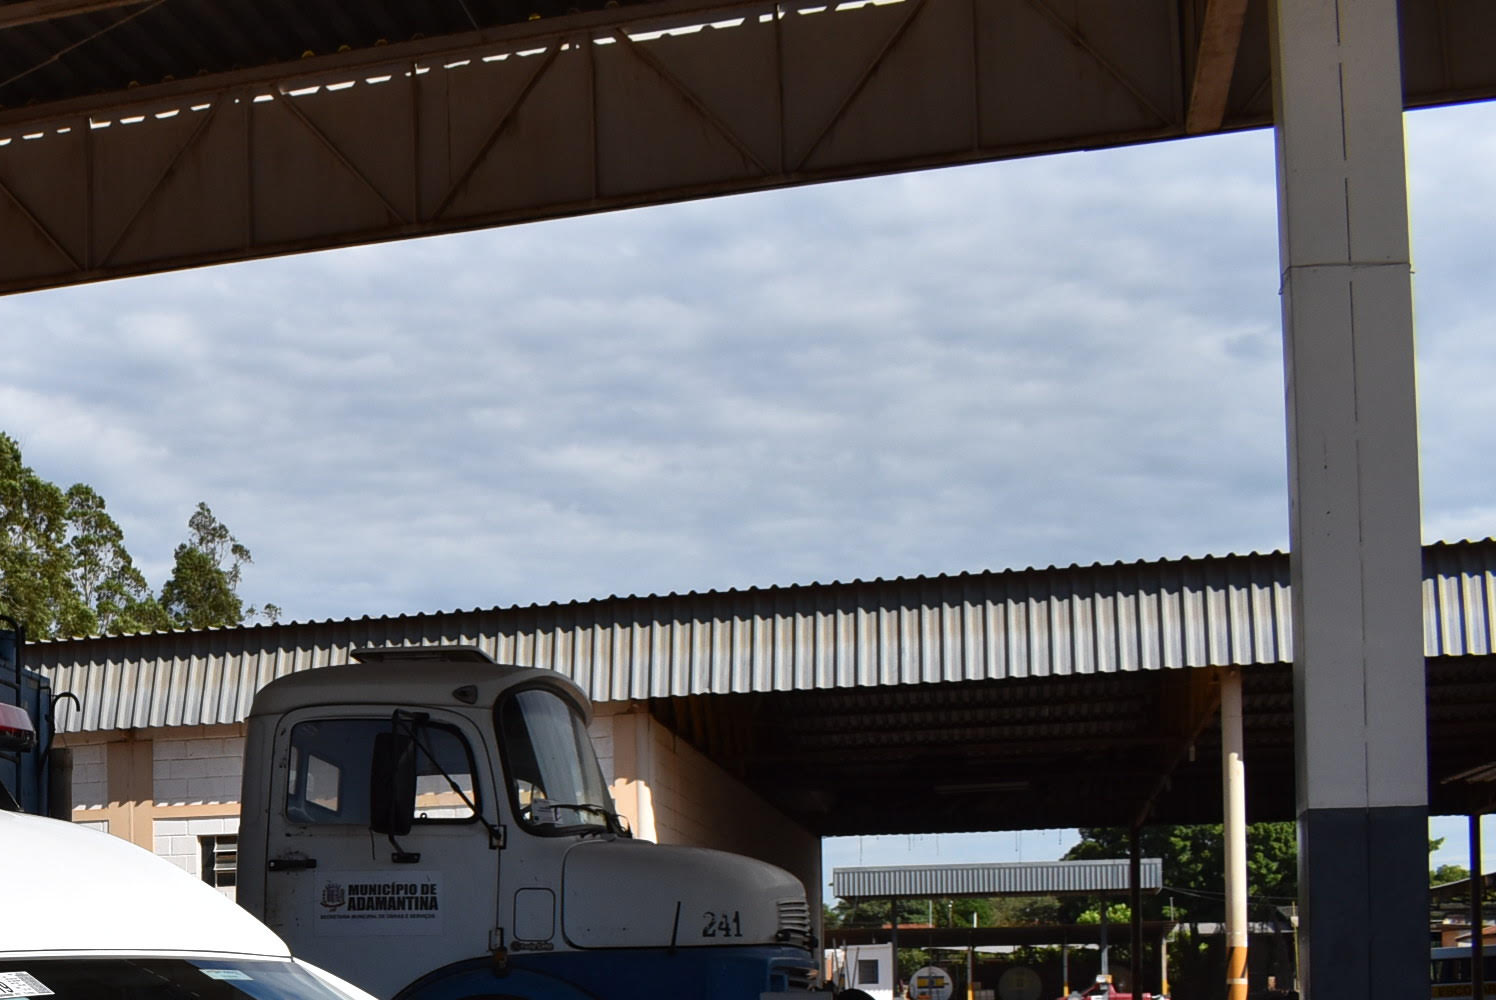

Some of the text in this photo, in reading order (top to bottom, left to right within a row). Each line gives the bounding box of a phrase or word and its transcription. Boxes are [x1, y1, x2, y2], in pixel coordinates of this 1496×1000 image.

[348, 882, 437, 895] MUNICÍPIO DE
[347, 896, 439, 911] ADAMANTINA
[702, 910, 744, 938] 241
